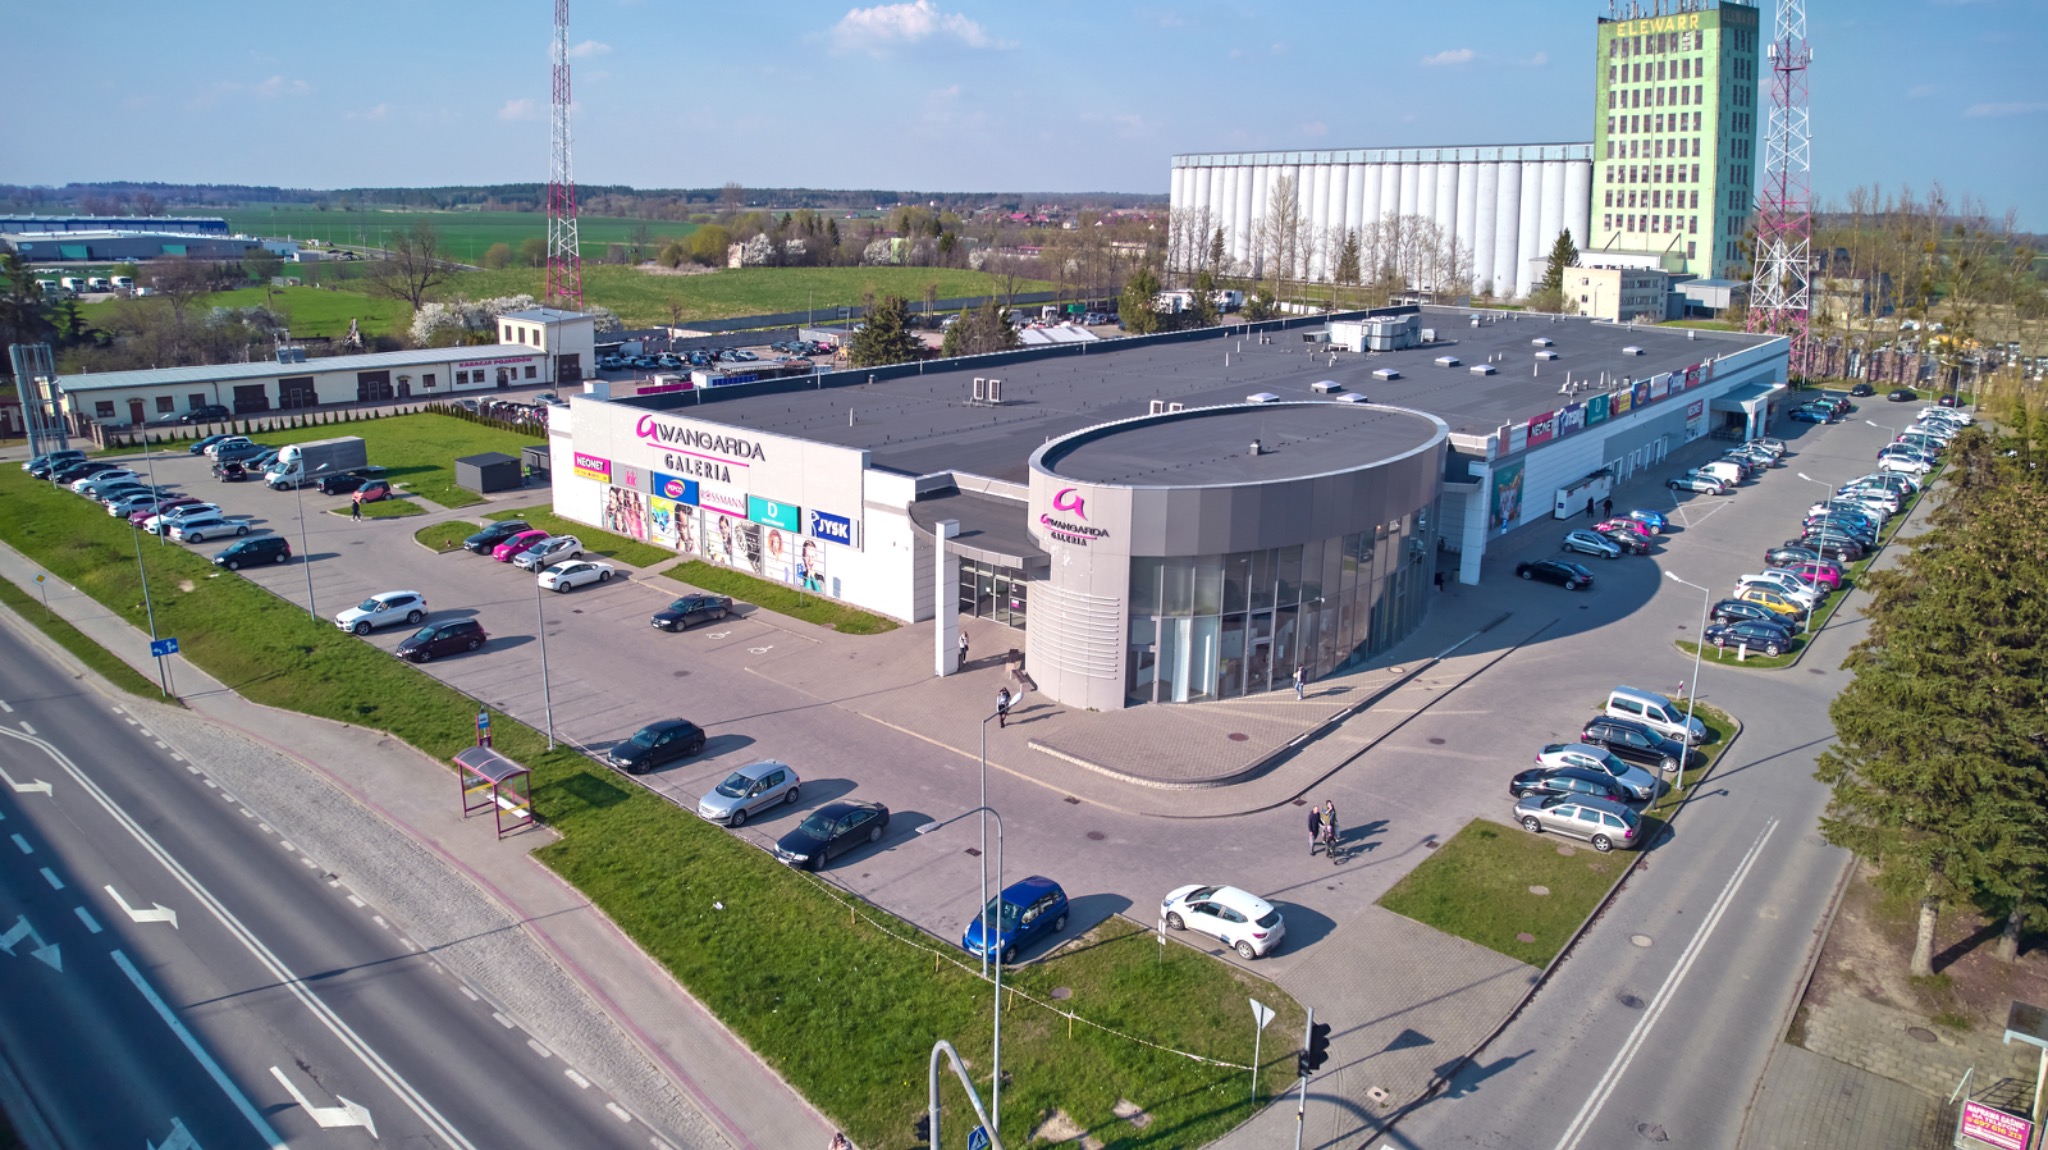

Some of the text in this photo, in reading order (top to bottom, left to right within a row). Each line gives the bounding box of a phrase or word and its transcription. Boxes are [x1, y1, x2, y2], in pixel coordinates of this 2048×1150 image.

[1617, 14, 1699, 37] ELEWARR
[576, 456, 605, 471] NEONET
[664, 453, 732, 483] GALERIA
[700, 490, 745, 509] ROSSMANN
[767, 502, 778, 518] D
[817, 519, 848, 538] JYSK
[1051, 533, 1087, 546] GALERIA
